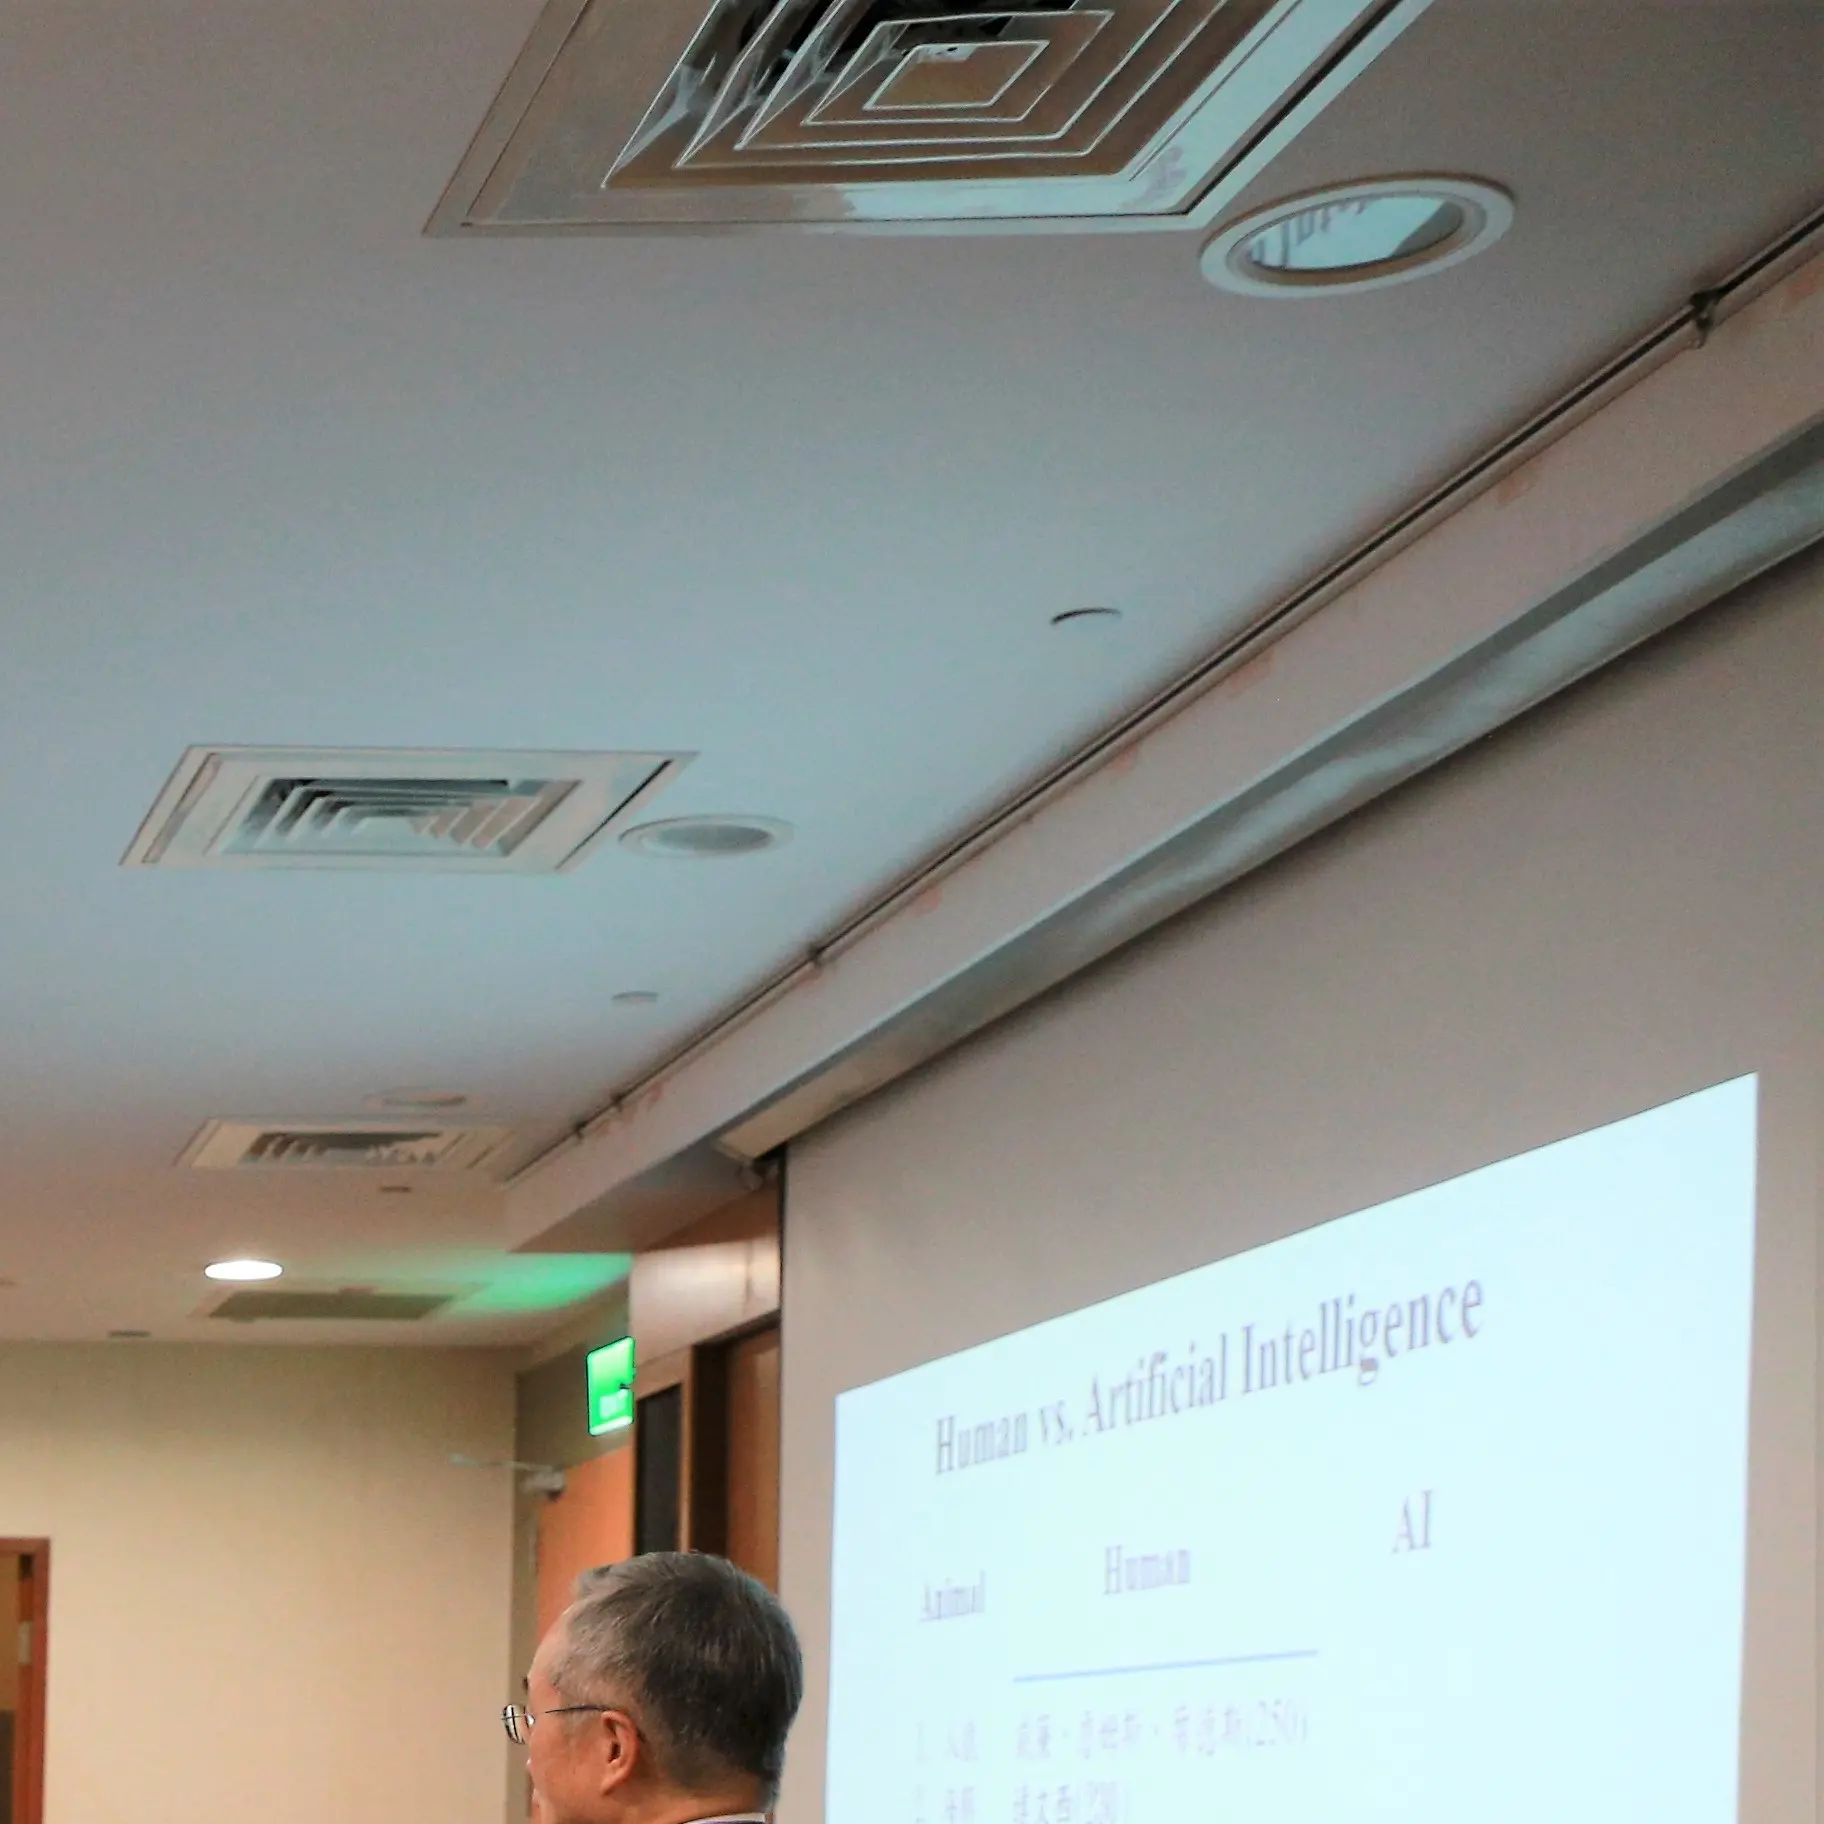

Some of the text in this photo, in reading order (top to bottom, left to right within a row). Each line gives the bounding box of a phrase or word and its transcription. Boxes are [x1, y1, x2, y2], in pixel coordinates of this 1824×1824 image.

[935, 1274, 1486, 1477] Human vs. Artificial Intelligence
[1392, 1488, 1434, 1555] AI
[1103, 1544, 1191, 1598] Human
